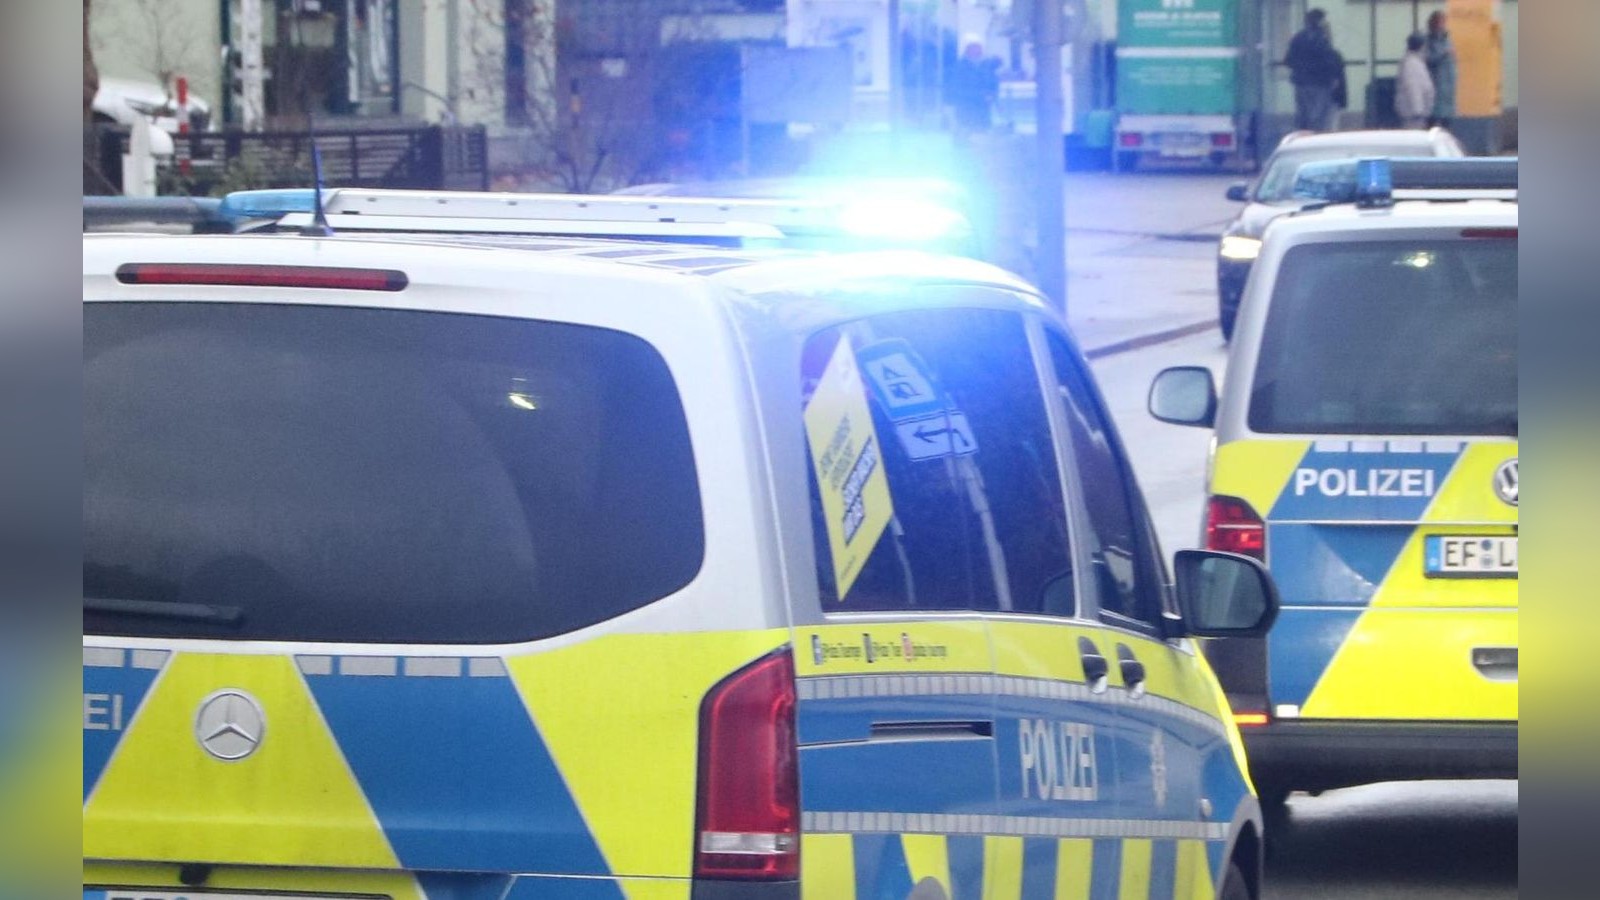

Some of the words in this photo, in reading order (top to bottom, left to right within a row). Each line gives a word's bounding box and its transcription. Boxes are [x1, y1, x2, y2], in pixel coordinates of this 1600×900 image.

[1295, 468, 1434, 496] POLIZEI
[1445, 541, 1477, 567] EF
[1499, 541, 1518, 567] L
[1019, 718, 1098, 802] POLIZEI
